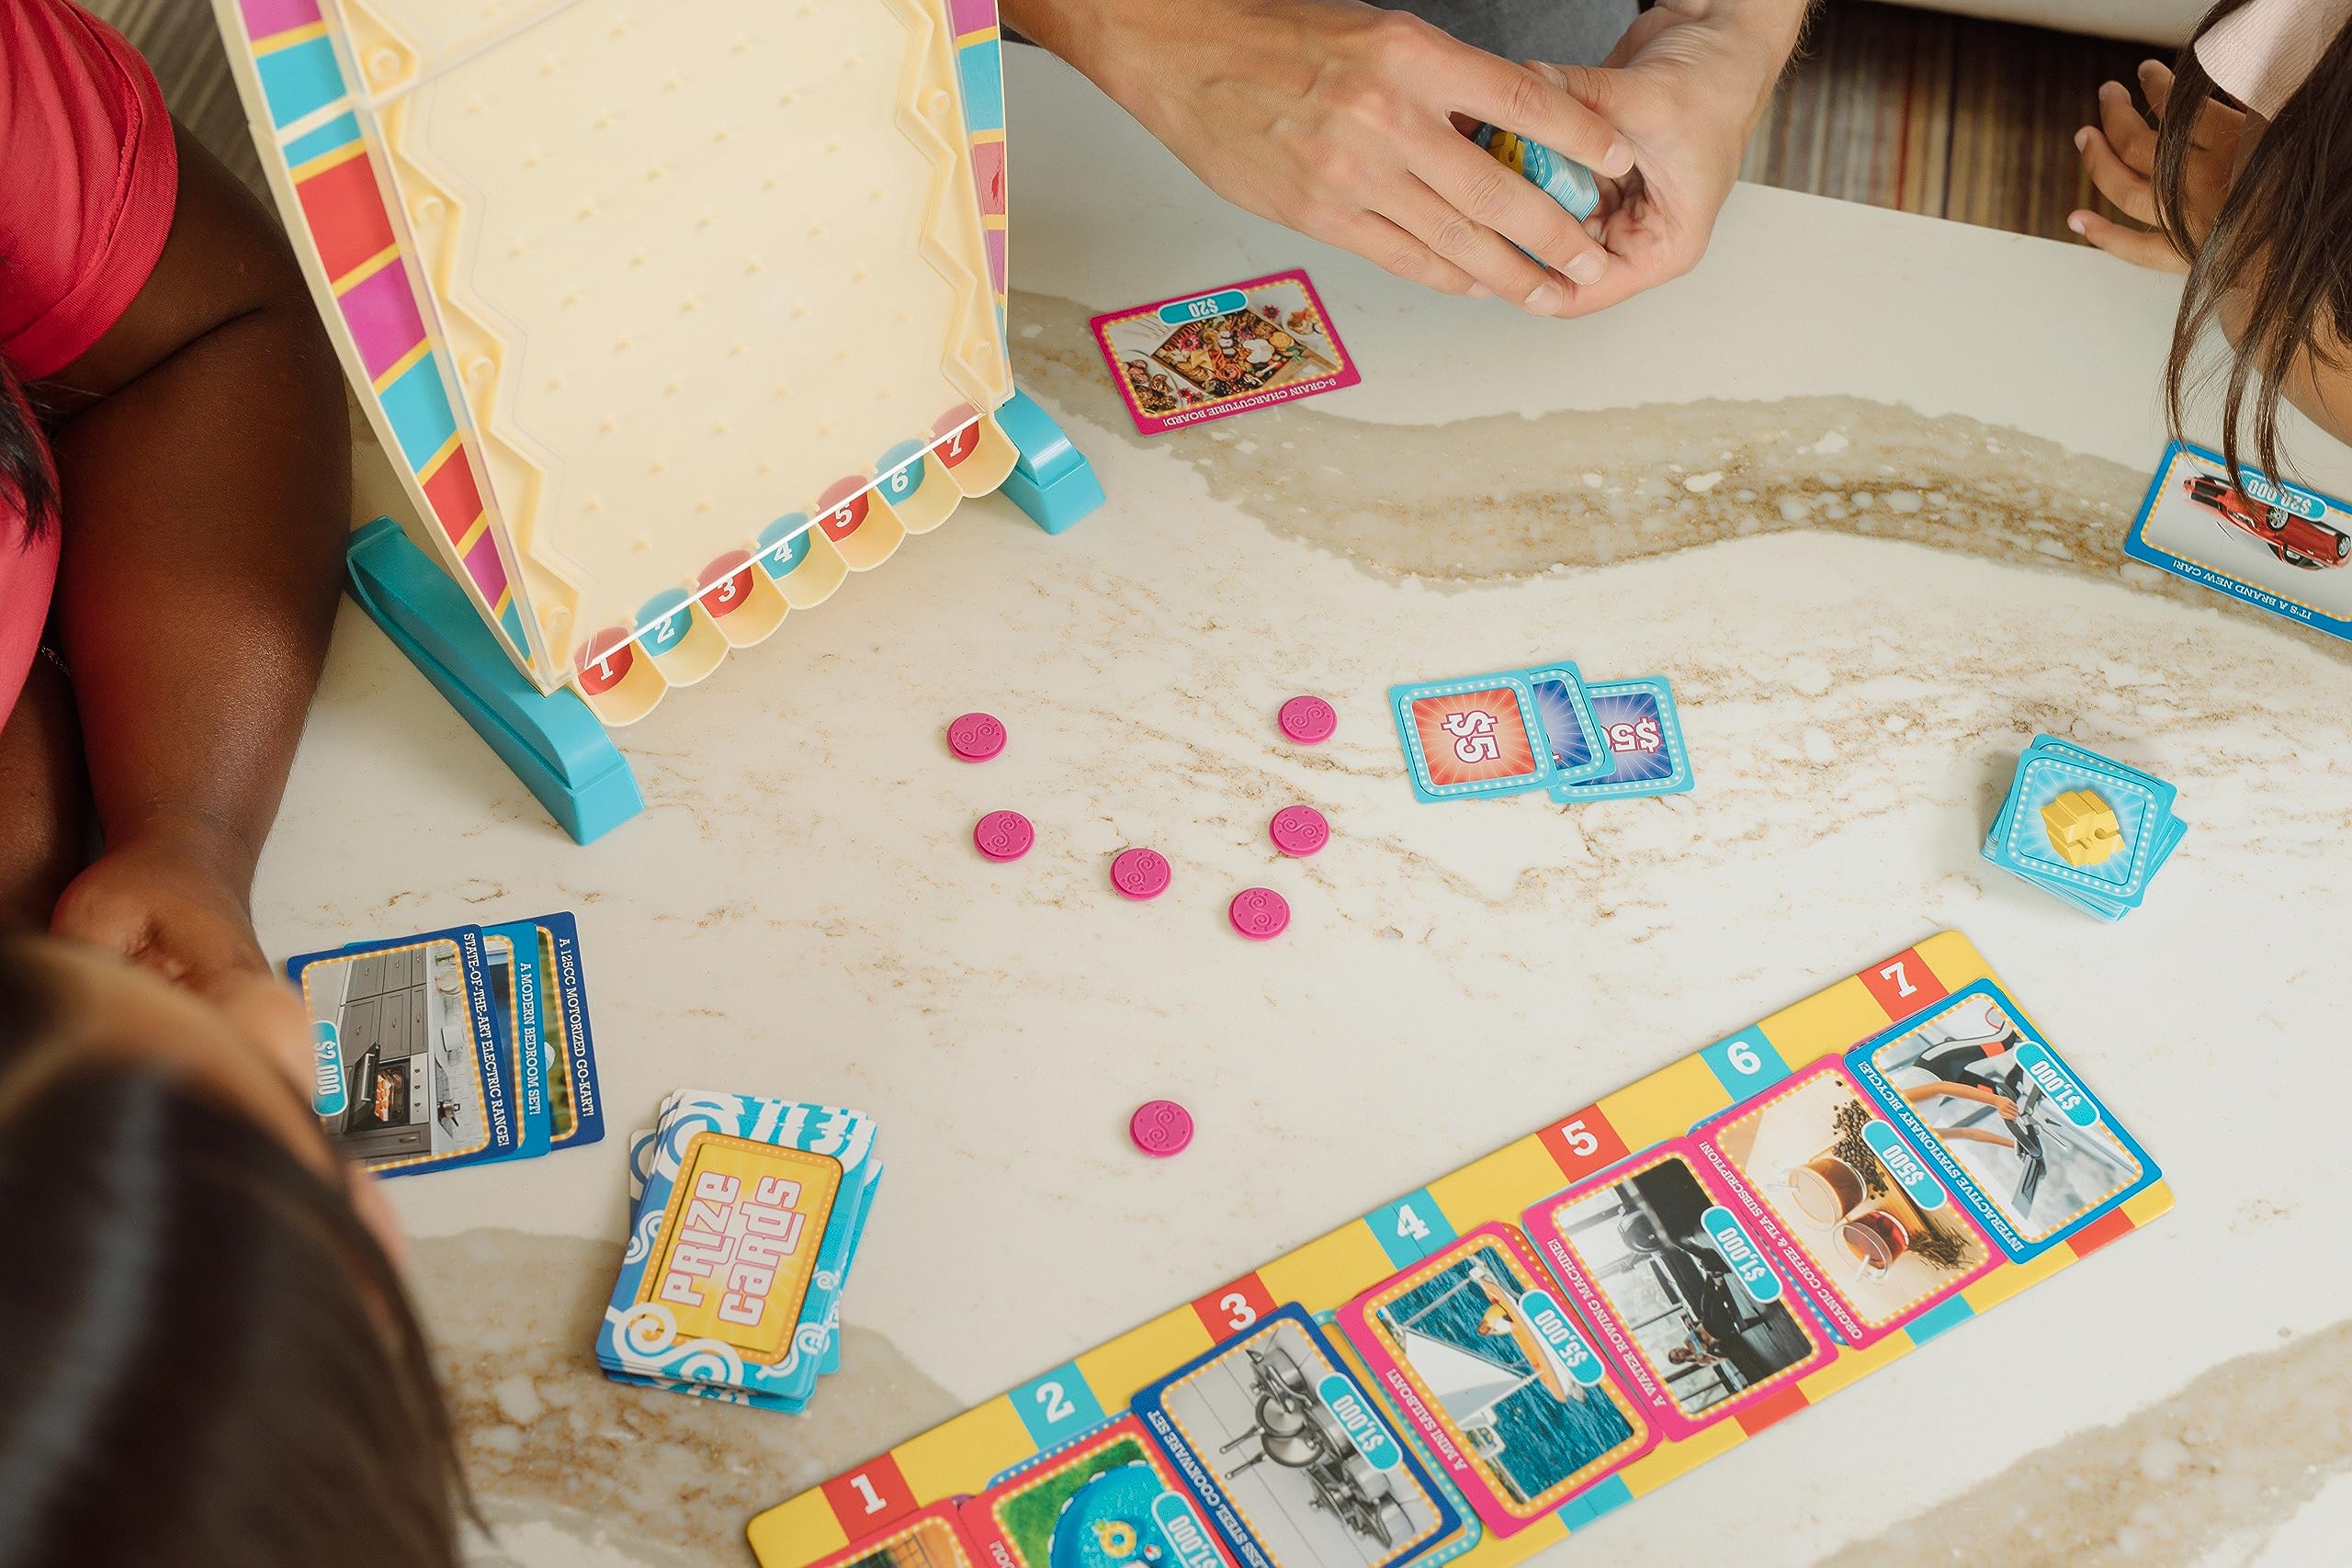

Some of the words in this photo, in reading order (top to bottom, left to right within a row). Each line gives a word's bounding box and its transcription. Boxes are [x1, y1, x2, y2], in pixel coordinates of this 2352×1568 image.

[1188, 295, 1220, 321] $20
[1206, 390, 1287, 416] CHARCUTURIE
[1290, 378, 1336, 396] 9-GRAIN
[1163, 411, 1206, 426] BOARD!
[946, 431, 963, 458] 7
[890, 468, 909, 494] 6
[2247, 479, 2312, 514] $20000
[834, 506, 853, 528] 5
[773, 542, 793, 564] 4
[2173, 560, 2201, 576] CAR!
[717, 577, 736, 603] 3
[2203, 573, 2233, 589] NEW
[2235, 585, 2277, 605] BRAND
[2279, 601, 2288, 610] A
[2290, 605, 2312, 619] IT'S
[653, 616, 675, 643] 2
[599, 660, 615, 681] 1
[1441, 709, 1501, 763] $5
[560, 939, 570, 947] A
[521, 963, 531, 972] A
[561, 950, 575, 985] 125CC
[1879, 962, 1917, 999] 7
[521, 974, 535, 1024] MODERN
[464, 933, 492, 1038] STATE-OF-THE-ART
[481, 1040, 501, 1098] ELECTRIC
[492, 1100, 509, 1146] RANGE!
[566, 987, 585, 1056] MOTORIZED
[525, 1027, 538, 1088] BEDROOM
[1726, 1040, 1762, 1076] 6
[528, 1089, 540, 1114] SET!
[576, 1059, 594, 1116] GO-KART!
[1858, 1061, 1904, 1111] BICYCLE!
[2030, 1059, 2083, 1112] $1,000
[1560, 1120, 1598, 1157] 5
[1898, 1106, 1961, 1179] STATIONARY
[1699, 1142, 1763, 1216] SUBSCRIPTION!
[1882, 1144, 1926, 1188] $500
[1396, 1204, 1430, 1240] 4
[1759, 1214, 1780, 1239] TEA
[1956, 1173, 2024, 1252] INTERACTIVE
[1716, 1226, 1766, 1282] $1,000
[1778, 1236, 1788, 1247] &
[1547, 1239, 1594, 1300] MACHINE!
[1783, 1247, 1821, 1289] COFFEE
[1219, 1292, 1257, 1330] 3
[1588, 1300, 1629, 1353] ROWING
[1817, 1289, 1862, 1339] ORGANIC
[1533, 1309, 1589, 1368] $5,000
[1623, 1350, 1657, 1396] WATER
[1036, 1382, 1075, 1424] 2
[1386, 1369, 1437, 1431] SAILBOAT!
[1653, 1394, 1667, 1406] A
[1148, 1410, 1170, 1435] SET
[1332, 1393, 1385, 1451] $1,000
[1430, 1428, 1459, 1461] MINI
[1164, 1432, 1220, 1506] COOKWARE
[1453, 1458, 1467, 1470] A
[851, 1473, 888, 1515] 1
[1216, 1504, 1248, 1545] STEEL
